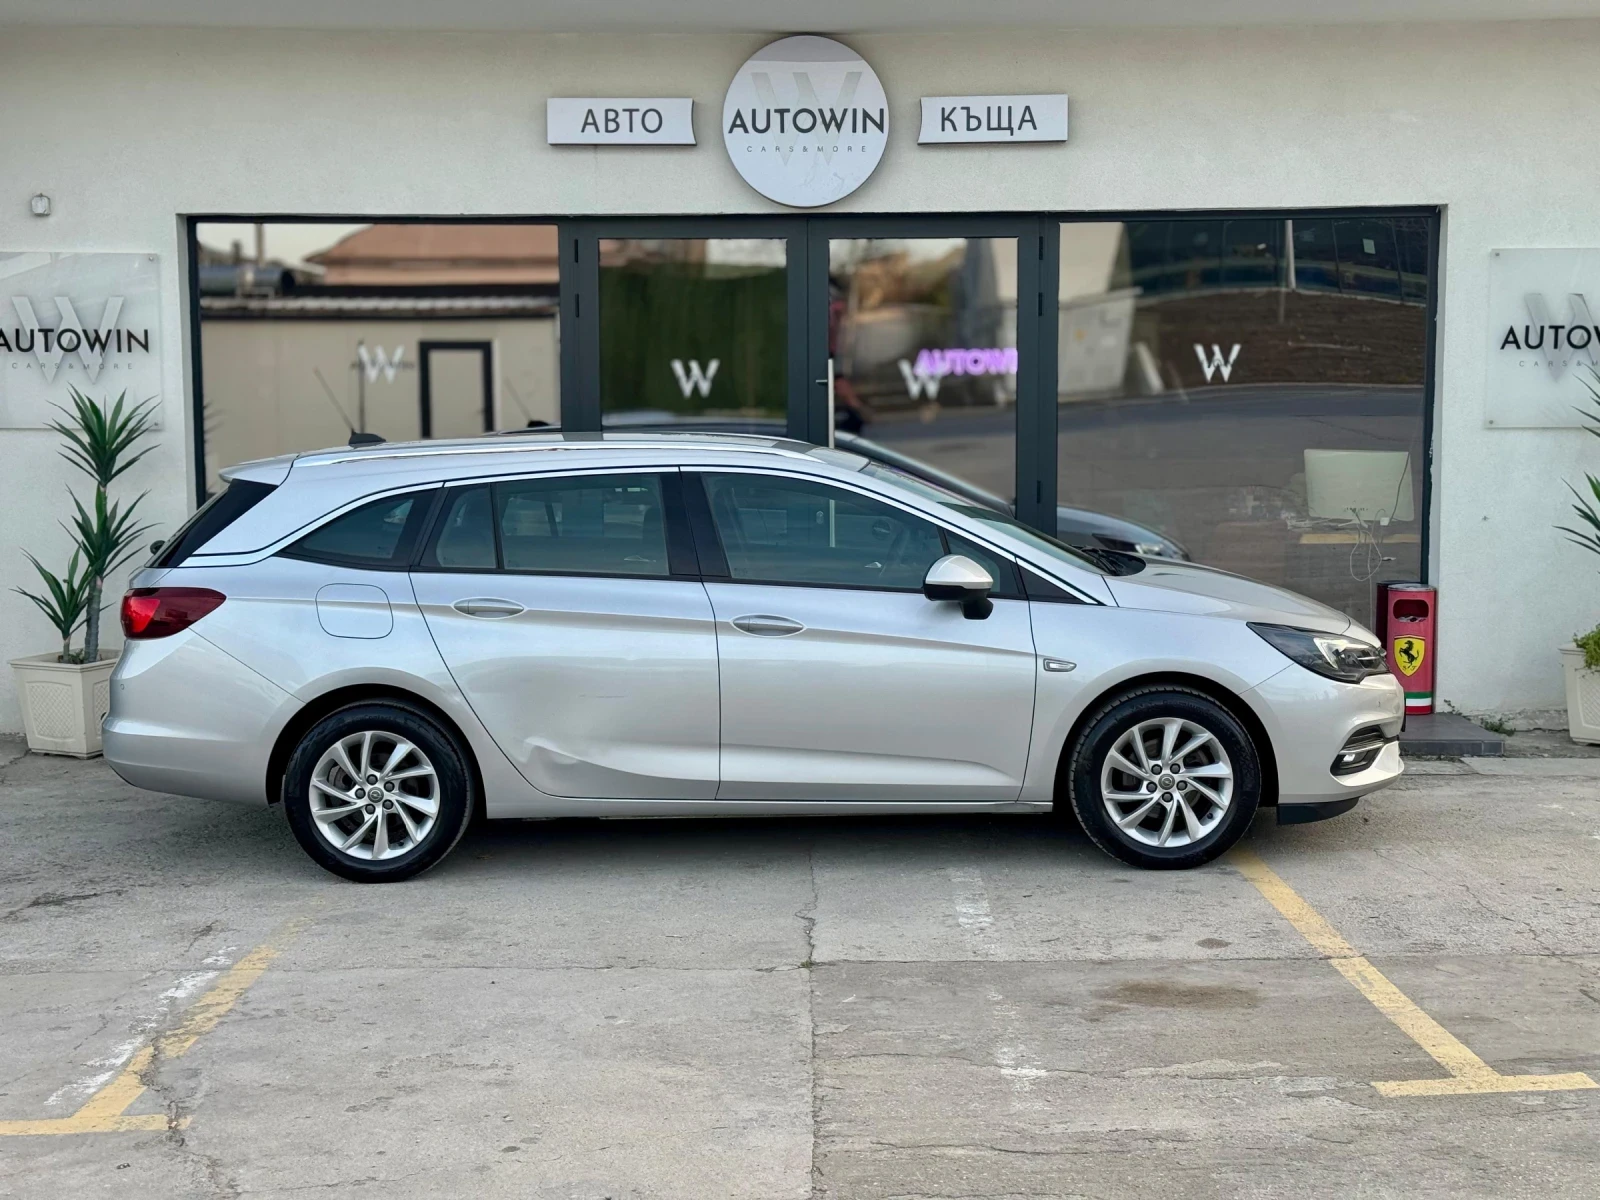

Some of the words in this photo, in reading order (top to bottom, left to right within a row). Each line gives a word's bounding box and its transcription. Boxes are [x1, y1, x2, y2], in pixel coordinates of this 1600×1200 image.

[580, 108, 663, 134] АВТО
[728, 107, 885, 134] AUTOWIN
[940, 105, 1038, 137] КЪЩА
[0, 328, 150, 353] AUTOWIN
[1500, 324, 1600, 350] AUTO
[358, 344, 405, 384] W
[671, 358, 720, 399] W
[1194, 343, 1242, 383] W
[898, 359, 943, 400] W
